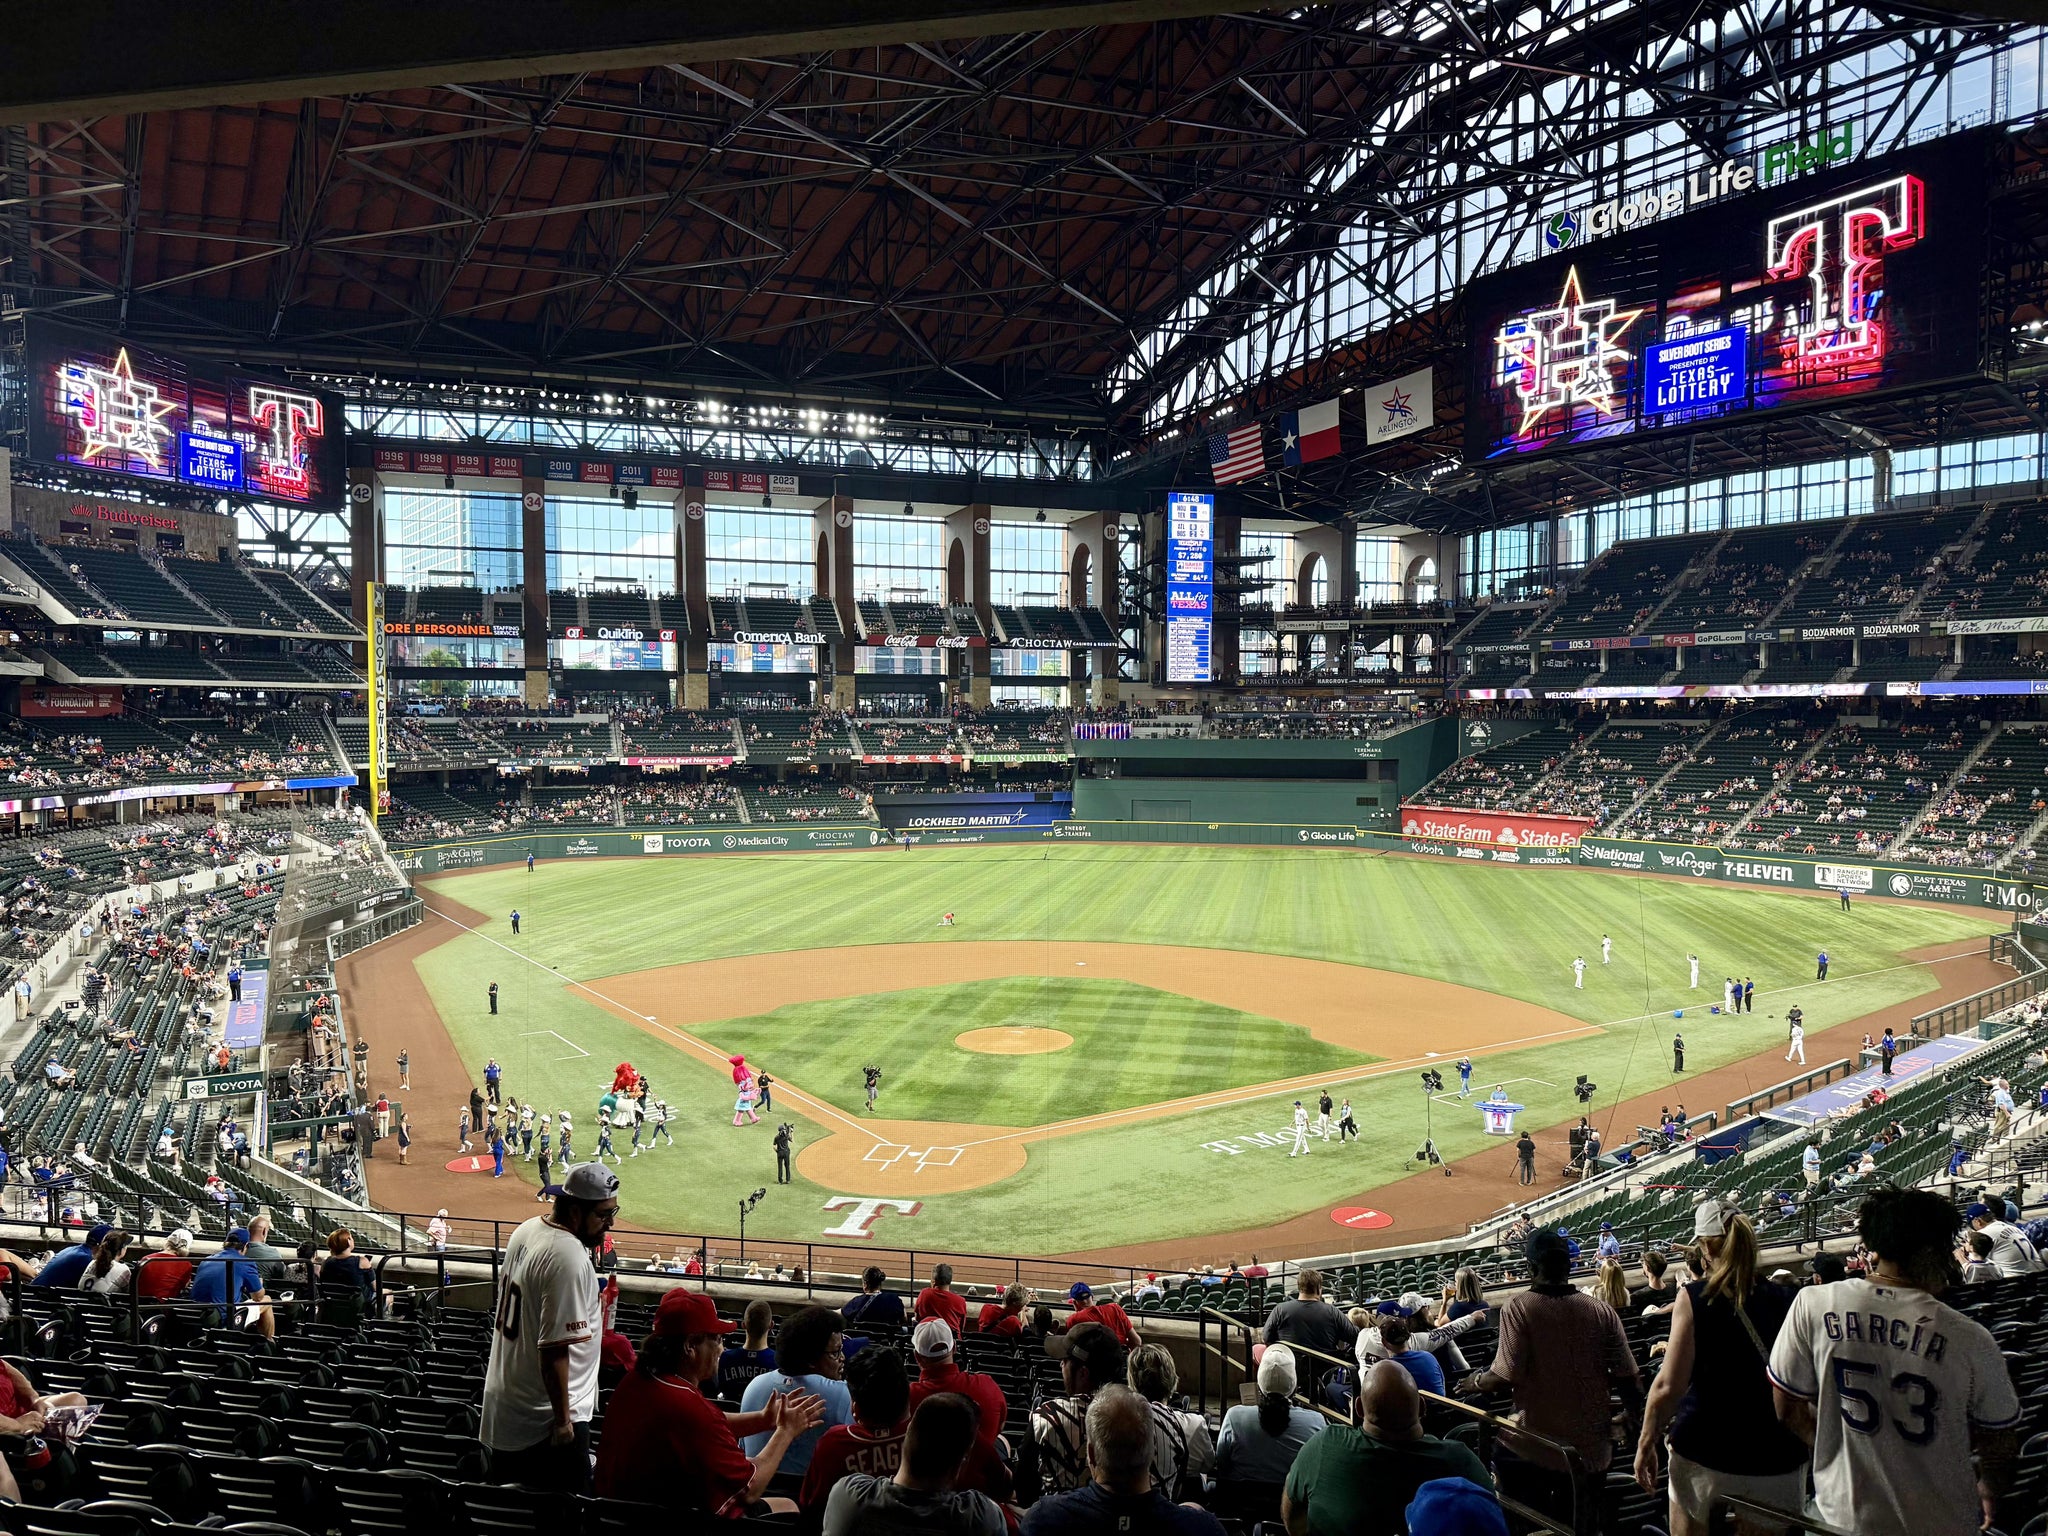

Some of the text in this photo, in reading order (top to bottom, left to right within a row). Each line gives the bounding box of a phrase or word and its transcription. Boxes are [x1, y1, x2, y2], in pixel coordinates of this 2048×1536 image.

[1587, 123, 1852, 235] Globe Life Field
[1659, 336, 1731, 363] SILVER BOOT SERIES
[1669, 357, 1708, 371] PRESENTED
[1671, 365, 1715, 386] TEXAS
[1658, 373, 1731, 407] LOTTERY
[1377, 416, 1418, 435] ARLINGTON
[189, 438, 205, 448] SILVER
[380, 451, 404, 461] 1996
[419, 453, 442, 463] 1998
[456, 455, 479, 465] 1999
[198, 456, 225, 469] TEXAS
[494, 458, 517, 467] 2010
[549, 461, 571, 470] 2010
[190, 461, 234, 481] LOTTERY
[587, 464, 607, 473] 2011
[622, 466, 641, 475] 2011
[657, 468, 678, 477] 2012
[708, 472, 728, 481] 2015
[742, 474, 762, 483] 2016
[773, 476, 794, 485] 2023
[354, 488, 369, 499] 42
[526, 496, 541, 507] 34
[688, 506, 703, 516] 26
[96, 505, 179, 528] Budweiser
[841, 514, 848, 524] 7
[976, 522, 988, 531] 29
[1107, 527, 1115, 537] 10
[1170, 591, 1209, 606] ALL for
[1170, 600, 1208, 610] TEXAS
[415, 624, 493, 635] PERSONNEL
[1802, 626, 1855, 637] BODYARMOR
[1863, 624, 1920, 635] BODYARMOR
[1950, 620, 2023, 633] Blue Mint
[567, 628, 581, 638] QT
[597, 627, 644, 640] QuikTrip
[660, 630, 675, 641] QT
[795, 632, 826, 643] Bank
[1697, 633, 1742, 643] GoPGL.com
[1755, 632, 1776, 641] PGL
[1016, 638, 1073, 648] CHOCTAW
[1568, 641, 1590, 649] 105.3
[1672, 636, 1692, 644] PGL
[375, 620, 384, 672] ROOT
[1474, 643, 1530, 653] PRIORITY COMMERCE
[1545, 691, 1584, 699] WELCOME
[50, 698, 94, 708] FOUNDATION
[376, 699, 385, 776] CHIKIN
[692, 756, 724, 764] Network
[983, 753, 1067, 762] LUXOR STAFFING
[908, 815, 1011, 828] LOCKHEED MARTIN
[811, 831, 856, 840] CHOCTAW
[1311, 831, 1355, 841] Globe Life
[666, 838, 711, 848] TOYOTA
[738, 836, 789, 847] Medical City
[1412, 843, 1444, 856] Kubota
[1594, 847, 1645, 863] National
[1627, 861, 1641, 869] Rental
[1676, 851, 1718, 877] Kroger
[1723, 861, 1795, 882] 7-ELEVEN
[1837, 868, 1868, 877] RANGERS
[1837, 873, 1862, 881] SPORTS
[1914, 875, 1966, 887] EAST TEXAS
[1837, 878, 1871, 888] NETWORK
[1928, 884, 1951, 893] A&M
[1913, 889, 1967, 901] UNIVERSITY
[211, 1079, 263, 1092] TOYOTA
[822, 1196, 923, 1240] T
[2013, 1237, 2035, 1261] 17
[565, 1320, 588, 1332] TOKYO
[1823, 1311, 1950, 1365] GARCÍA
[1832, 1357, 1938, 1447] 53
[1118, 1516, 1131, 1531] FJ
